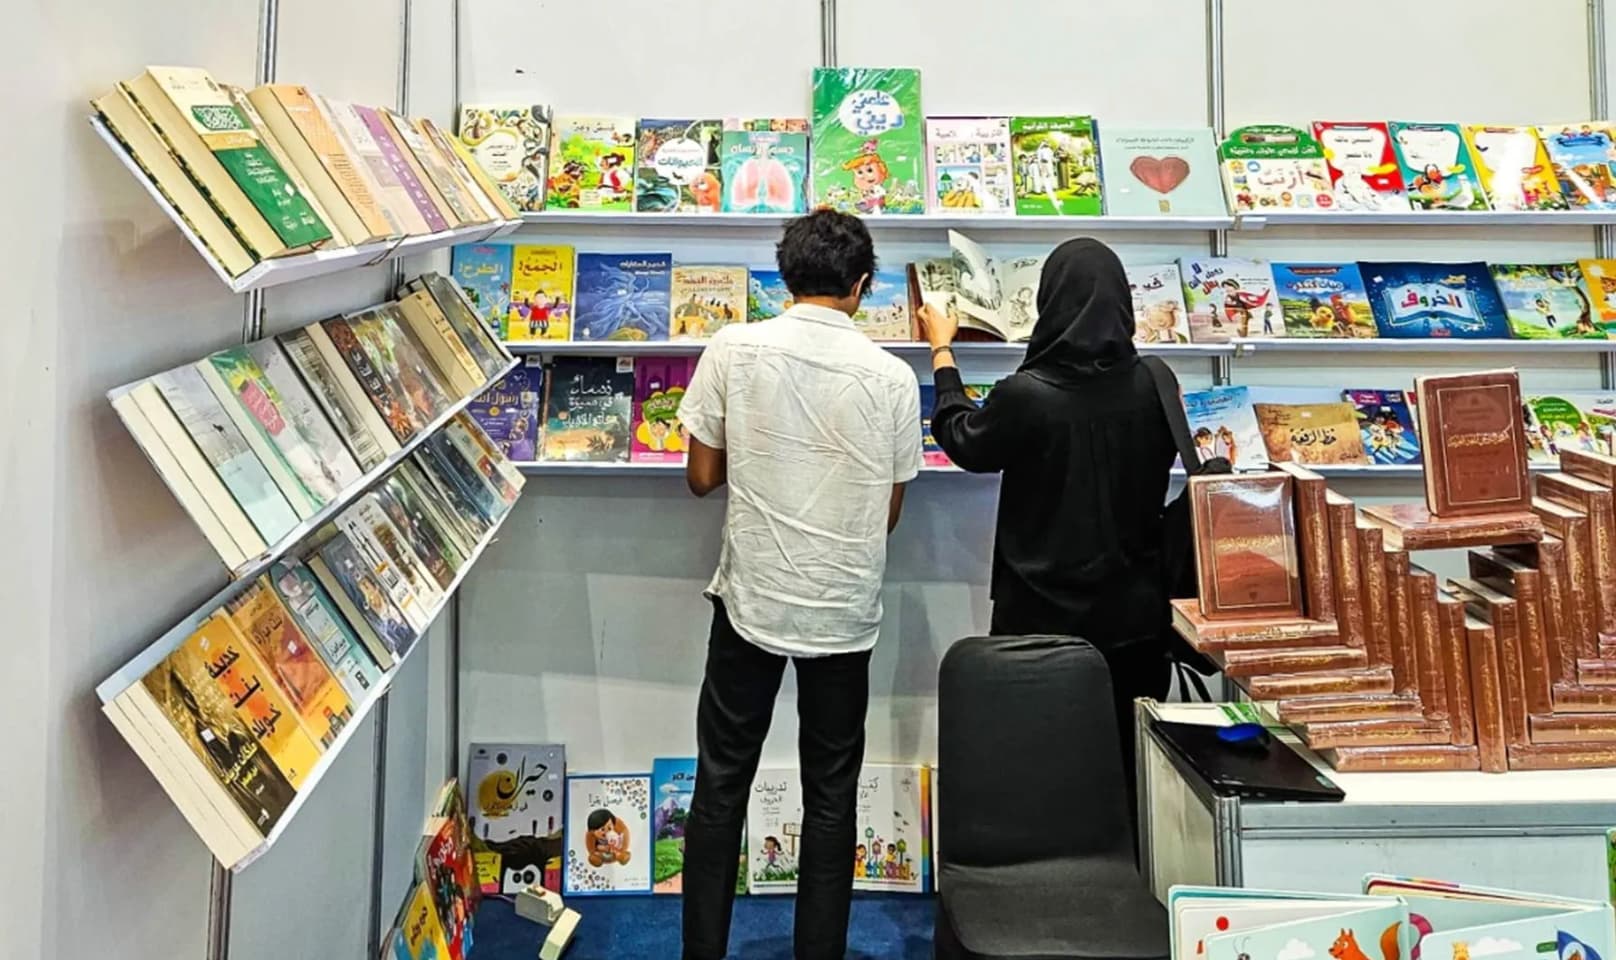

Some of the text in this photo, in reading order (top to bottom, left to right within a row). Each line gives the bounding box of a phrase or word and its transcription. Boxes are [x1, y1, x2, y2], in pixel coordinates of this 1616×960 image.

[1400, 288, 1464, 310] الخروف
[203, 645, 241, 680] خديجة
[229, 675, 265, 709] بنت
[251, 703, 282, 741] خويلد
